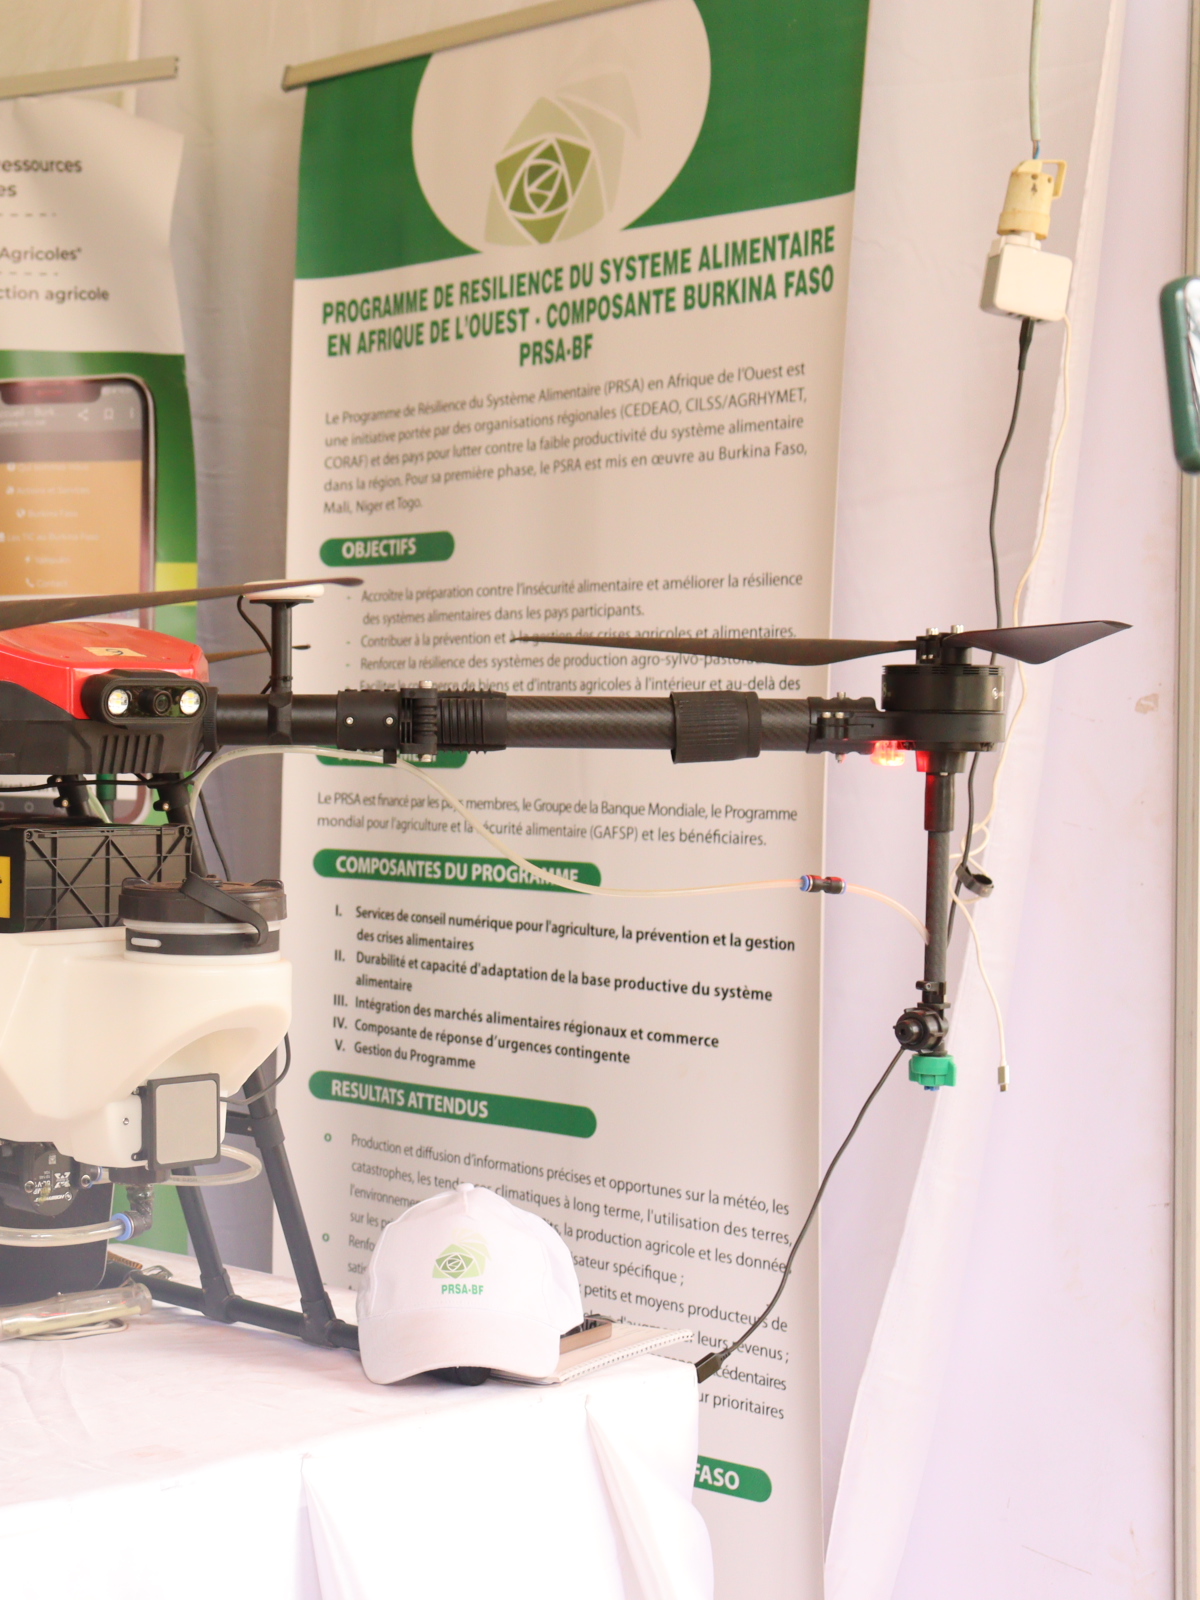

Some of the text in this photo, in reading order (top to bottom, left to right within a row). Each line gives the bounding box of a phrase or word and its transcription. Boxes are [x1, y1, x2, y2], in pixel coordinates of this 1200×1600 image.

[0, 247, 82, 263] Agricoles"
[322, 225, 835, 325] PROGRAMME DE RESILIENCE DU SYSTEME ALIMENTAIRE
[45, 286, 109, 302] agricole
[327, 264, 835, 357] EN AFRIQUE DE L'OUEST COMPOSANTE BURKINA FASO
[519, 335, 593, 367] PRSA-BF
[342, 538, 417, 559] OBJECTIFS
[336, 855, 467, 881] COMPOSANTES DU
[335, 905, 795, 951] I. Services de conseil numérique pour l'agriculture, la prévention et la gestion
[357, 929, 474, 951] des crises alimentaires
[335, 950, 773, 1001] II. Durabilité et capacité d'adaptation de la base productive du système
[356, 975, 412, 992] alimentaire
[333, 995, 719, 1048] III. Intégration des marchés alimentaires régionaux et commerce
[333, 1017, 631, 1064] IV. Composante de réponse d'urgences contingente
[335, 1039, 476, 1069] V. Gestion du Programme
[332, 1079, 488, 1118] RESULTATS ATTENDUS
[441, 1284, 484, 1295] PRSA-BF
